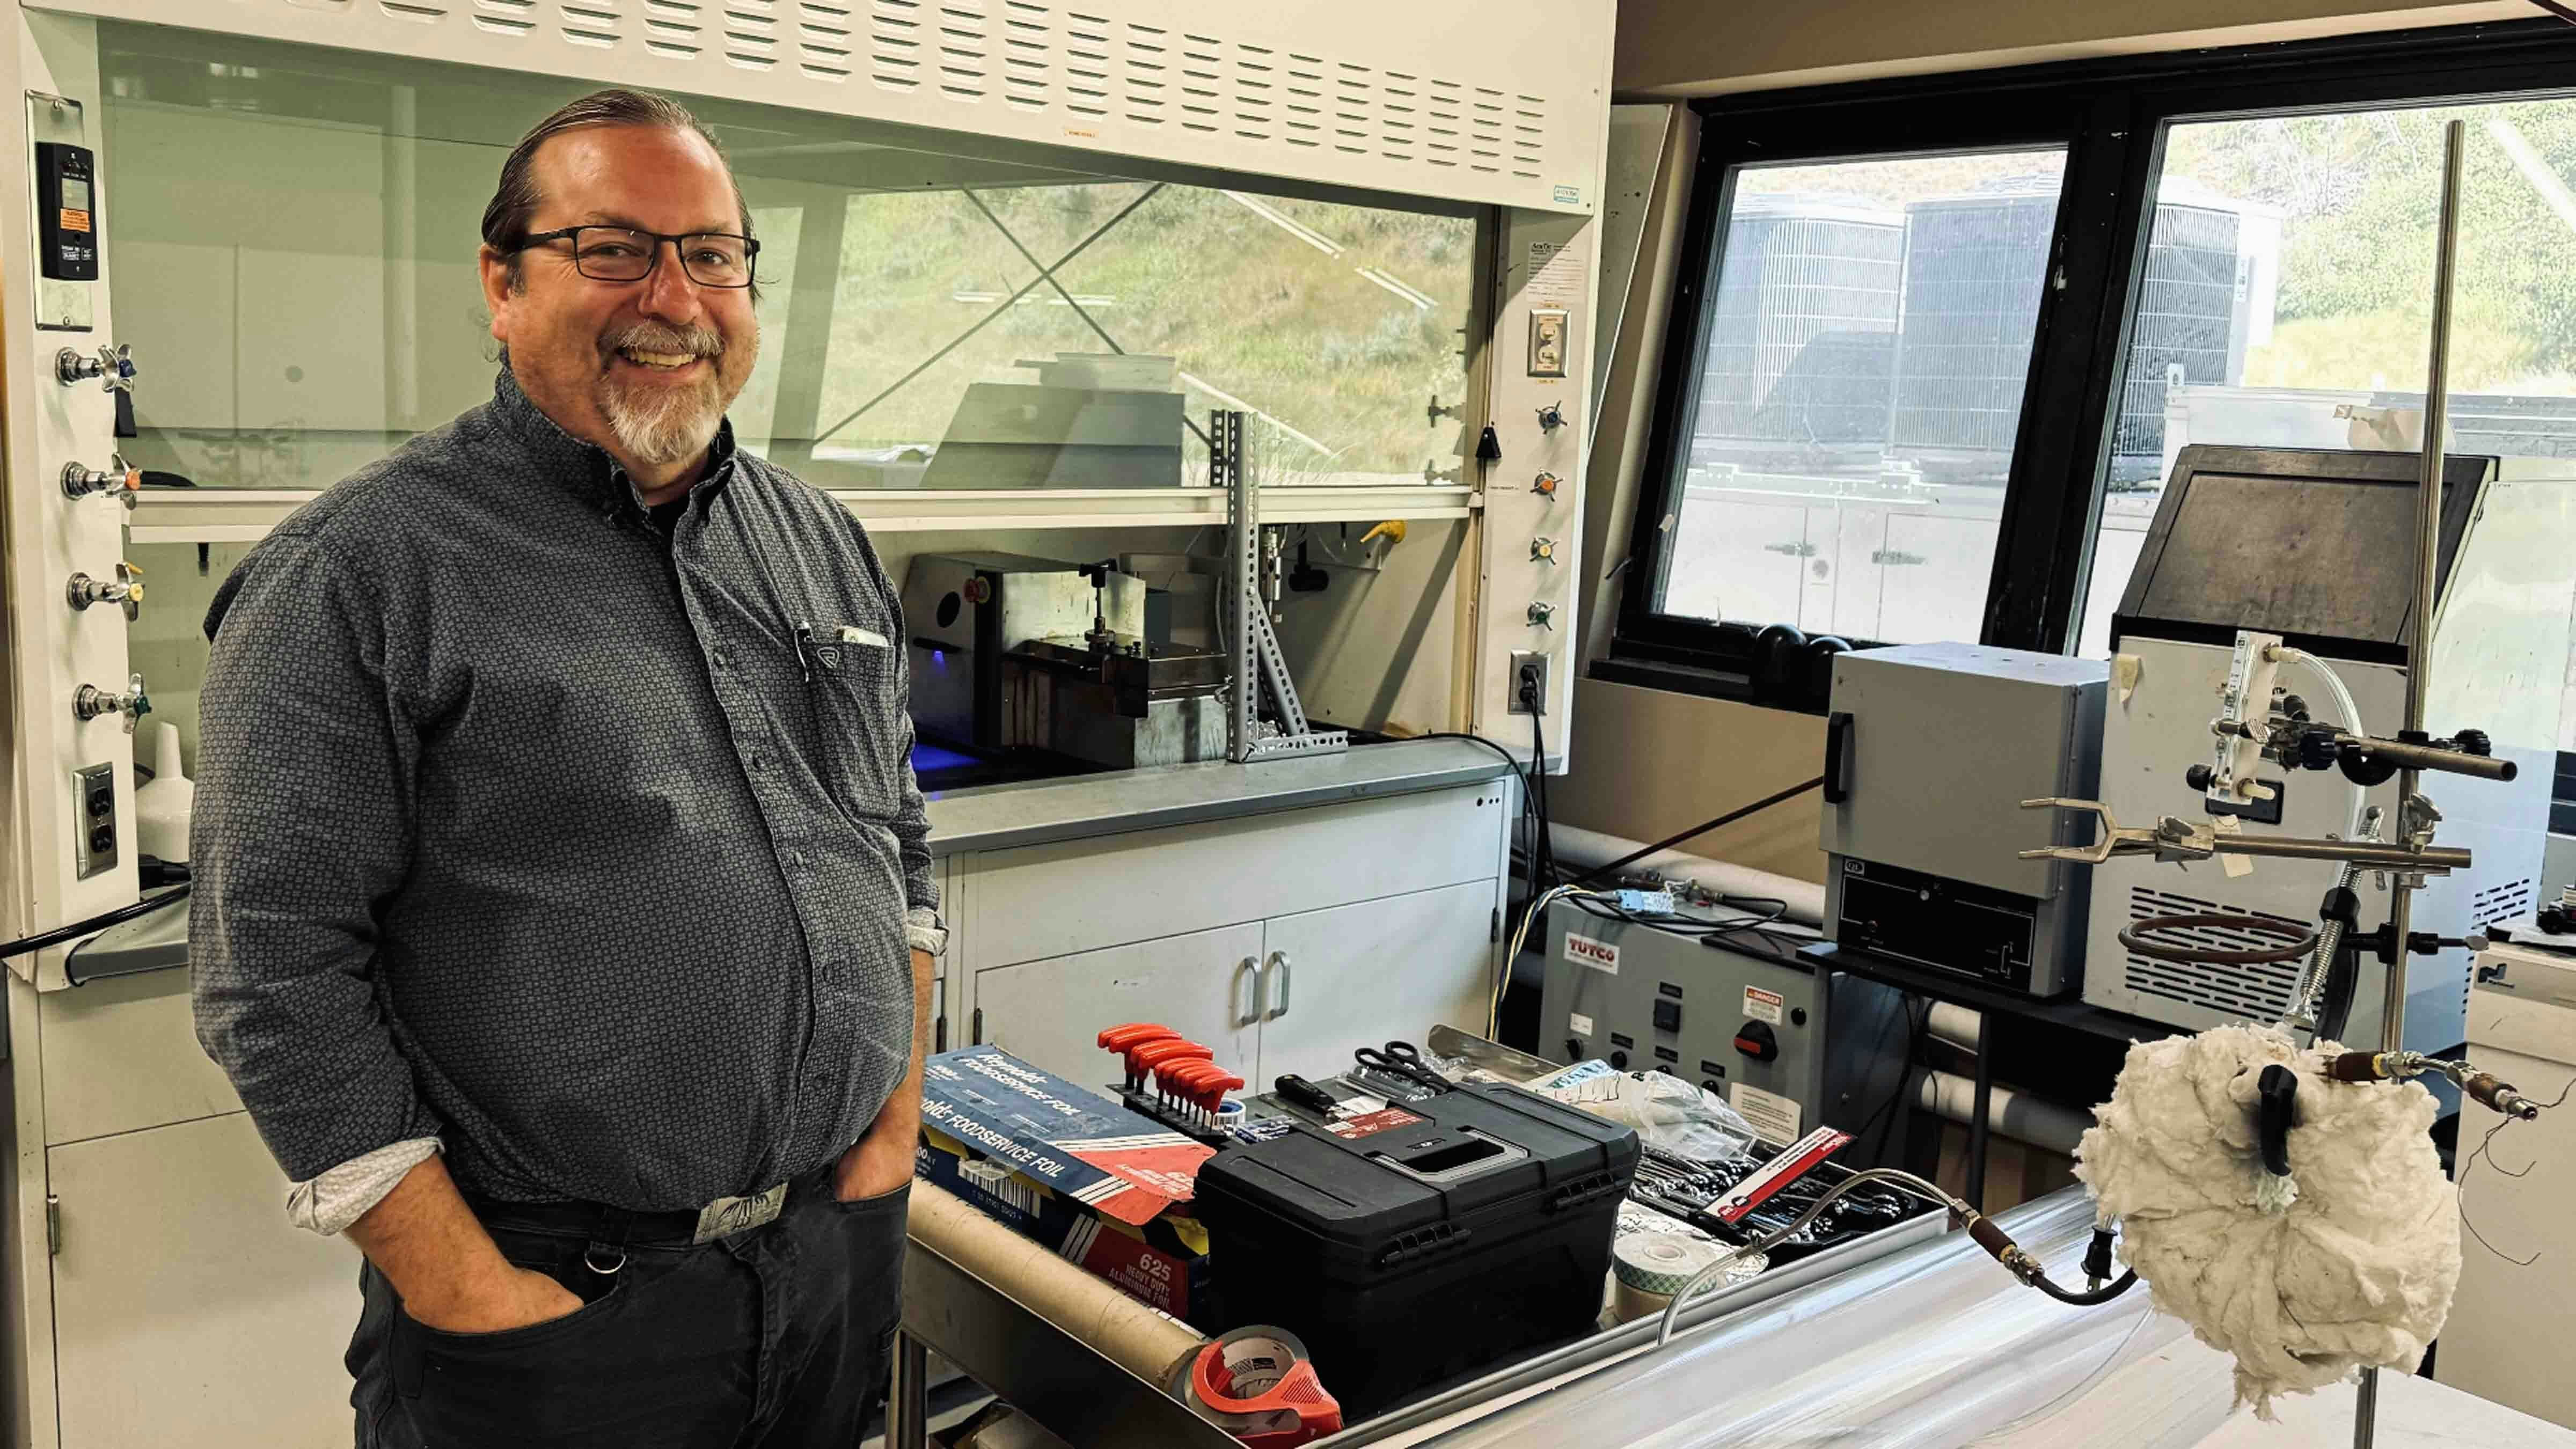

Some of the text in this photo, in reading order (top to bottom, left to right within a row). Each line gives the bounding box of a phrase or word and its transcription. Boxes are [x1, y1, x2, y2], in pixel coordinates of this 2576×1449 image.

[1569, 938, 1615, 962] TUTCO
[1753, 991, 1780, 1005] DANGER
[976, 1053, 1048, 1084] Reynolds
[957, 1058, 1053, 1100] FOODSERVICE
[1043, 1100, 1082, 1116] FOIL
[920, 1098, 954, 1119] olds
[945, 1114, 1038, 1162] FOODSERVICE
[1029, 1157, 1065, 1177] FOIL
[1140, 1253, 1172, 1282] 625
